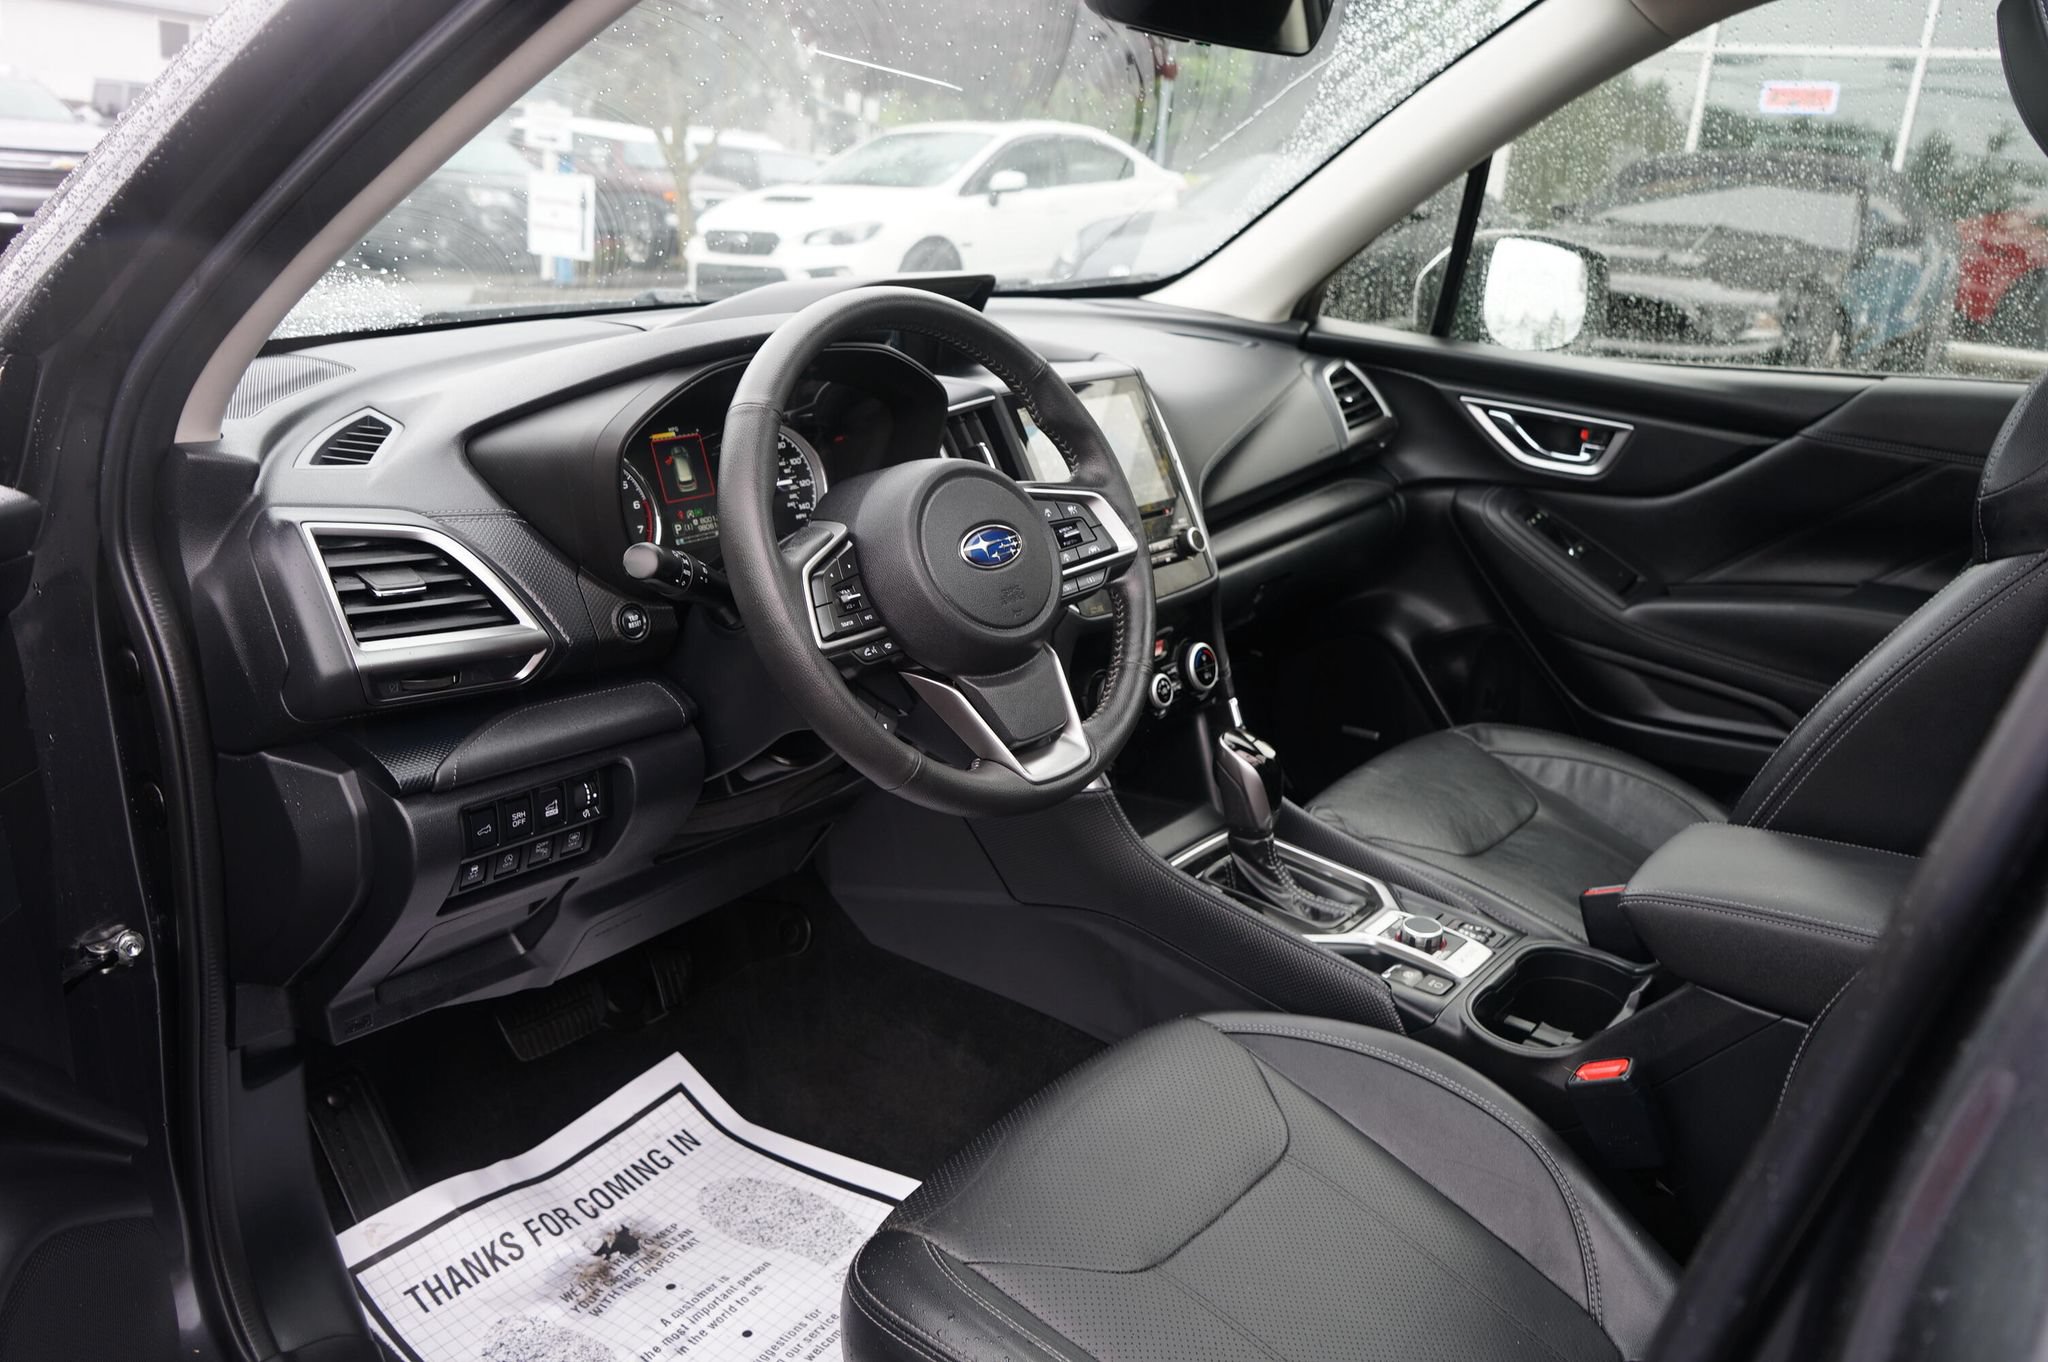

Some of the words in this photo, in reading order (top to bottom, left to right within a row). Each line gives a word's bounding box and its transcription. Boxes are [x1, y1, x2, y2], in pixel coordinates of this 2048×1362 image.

[622, 481, 629, 489] 5
[633, 501, 641, 510] 6
[637, 525, 645, 534] 7
[674, 523, 682, 535] P
[511, 810, 527, 821] SRH
[511, 818, 527, 828] OFF
[402, 1231, 525, 1314] THANKS
[522, 1207, 582, 1248] FOR
[574, 1148, 675, 1220] COMING
[667, 1128, 703, 1158] IN
[652, 1223, 679, 1242] KEEP
[570, 1288, 605, 1315] YOUR
[603, 1249, 662, 1288] CARPETING
[659, 1228, 695, 1251] CLEAN
[588, 1289, 622, 1318] WITH
[618, 1276, 646, 1294] THIS
[644, 1251, 680, 1278] PAPER
[676, 1237, 701, 1256] MAT
[640, 1345, 662, 1362] the
[662, 1323, 690, 1346] most
[686, 1283, 738, 1327] important
[737, 1260, 773, 1291] person
[659, 1317, 672, 1328] A
[671, 1282, 718, 1320] customer
[718, 1274, 731, 1285] is
[674, 1345, 690, 1356] in
[687, 1329, 709, 1346] the
[707, 1303, 739, 1330] world
[735, 1295, 750, 1308] to
[804, 1308, 822, 1322] for
[785, 1343, 804, 1358] our
[803, 1313, 840, 1344] service
[803, 1329, 841, 1361] welcom
